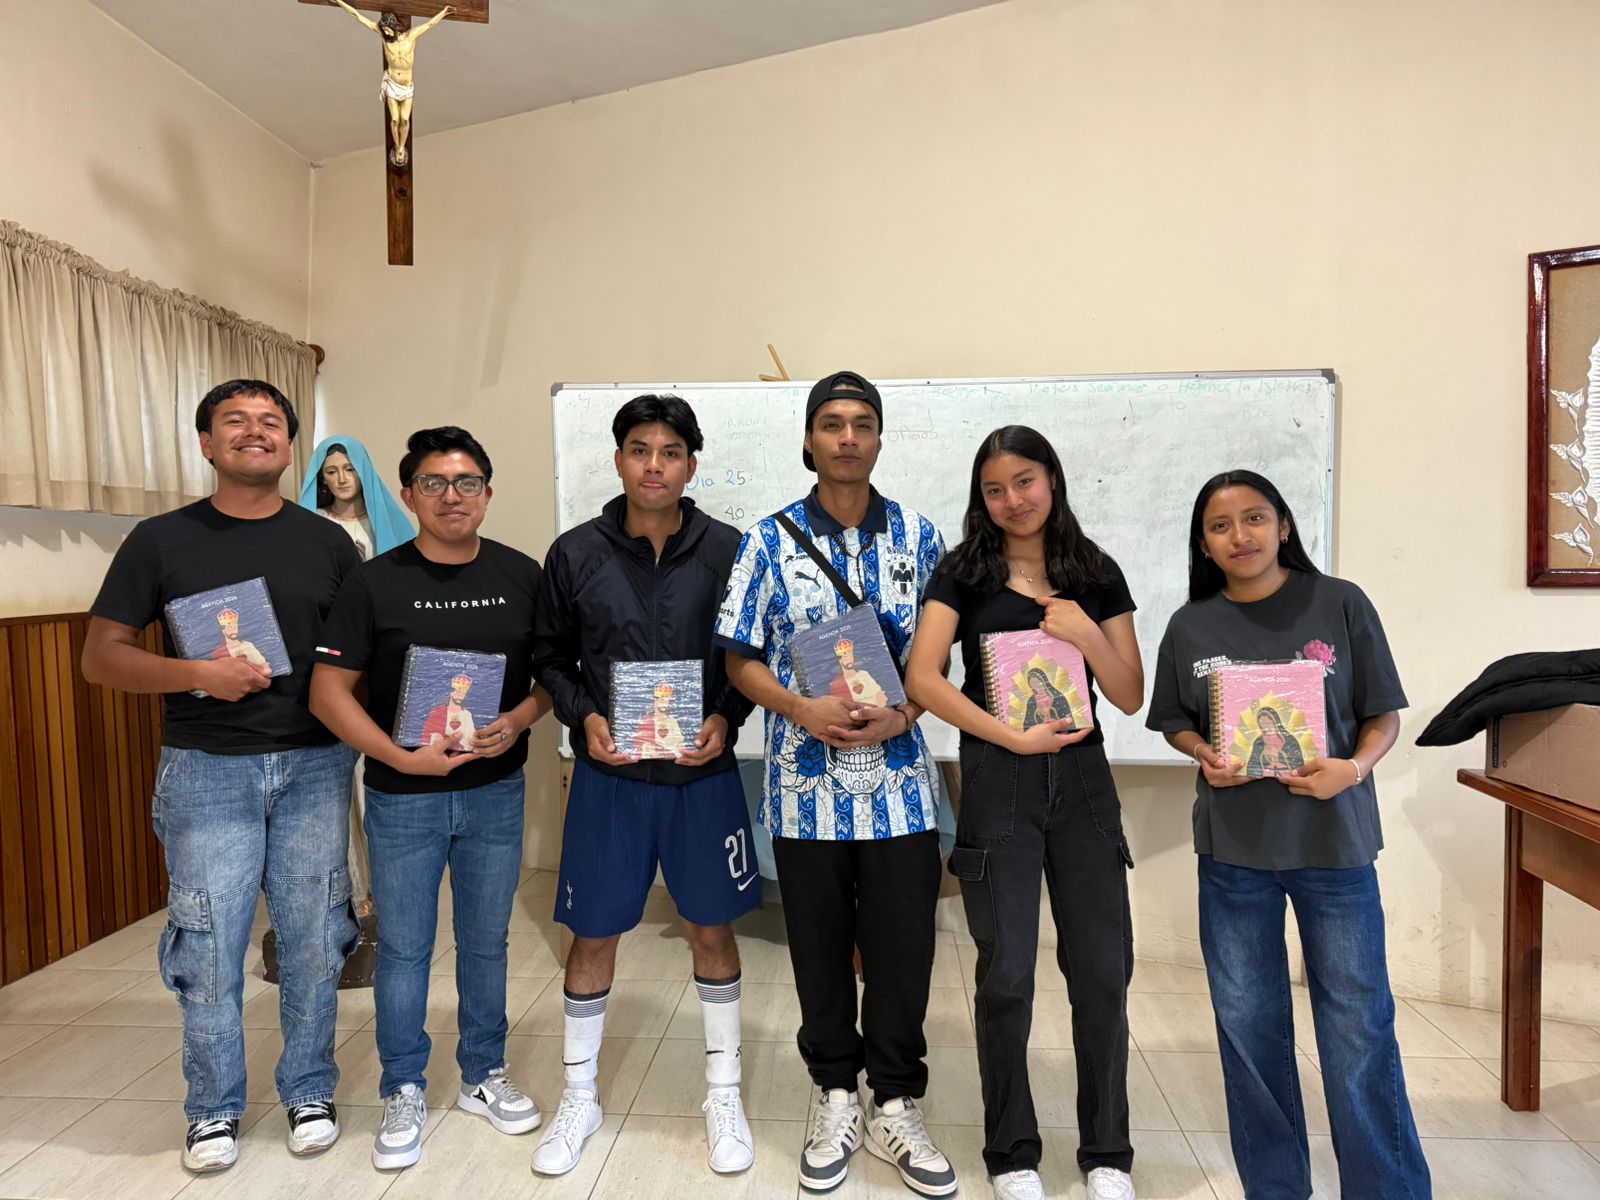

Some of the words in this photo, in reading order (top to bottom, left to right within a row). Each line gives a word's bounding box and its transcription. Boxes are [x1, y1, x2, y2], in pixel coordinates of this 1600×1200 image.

[201, 599, 224, 608] AGENDA
[414, 597, 506, 608] CALIFORNIA
[819, 629, 839, 640] AGENDA
[725, 828, 747, 878] 21
